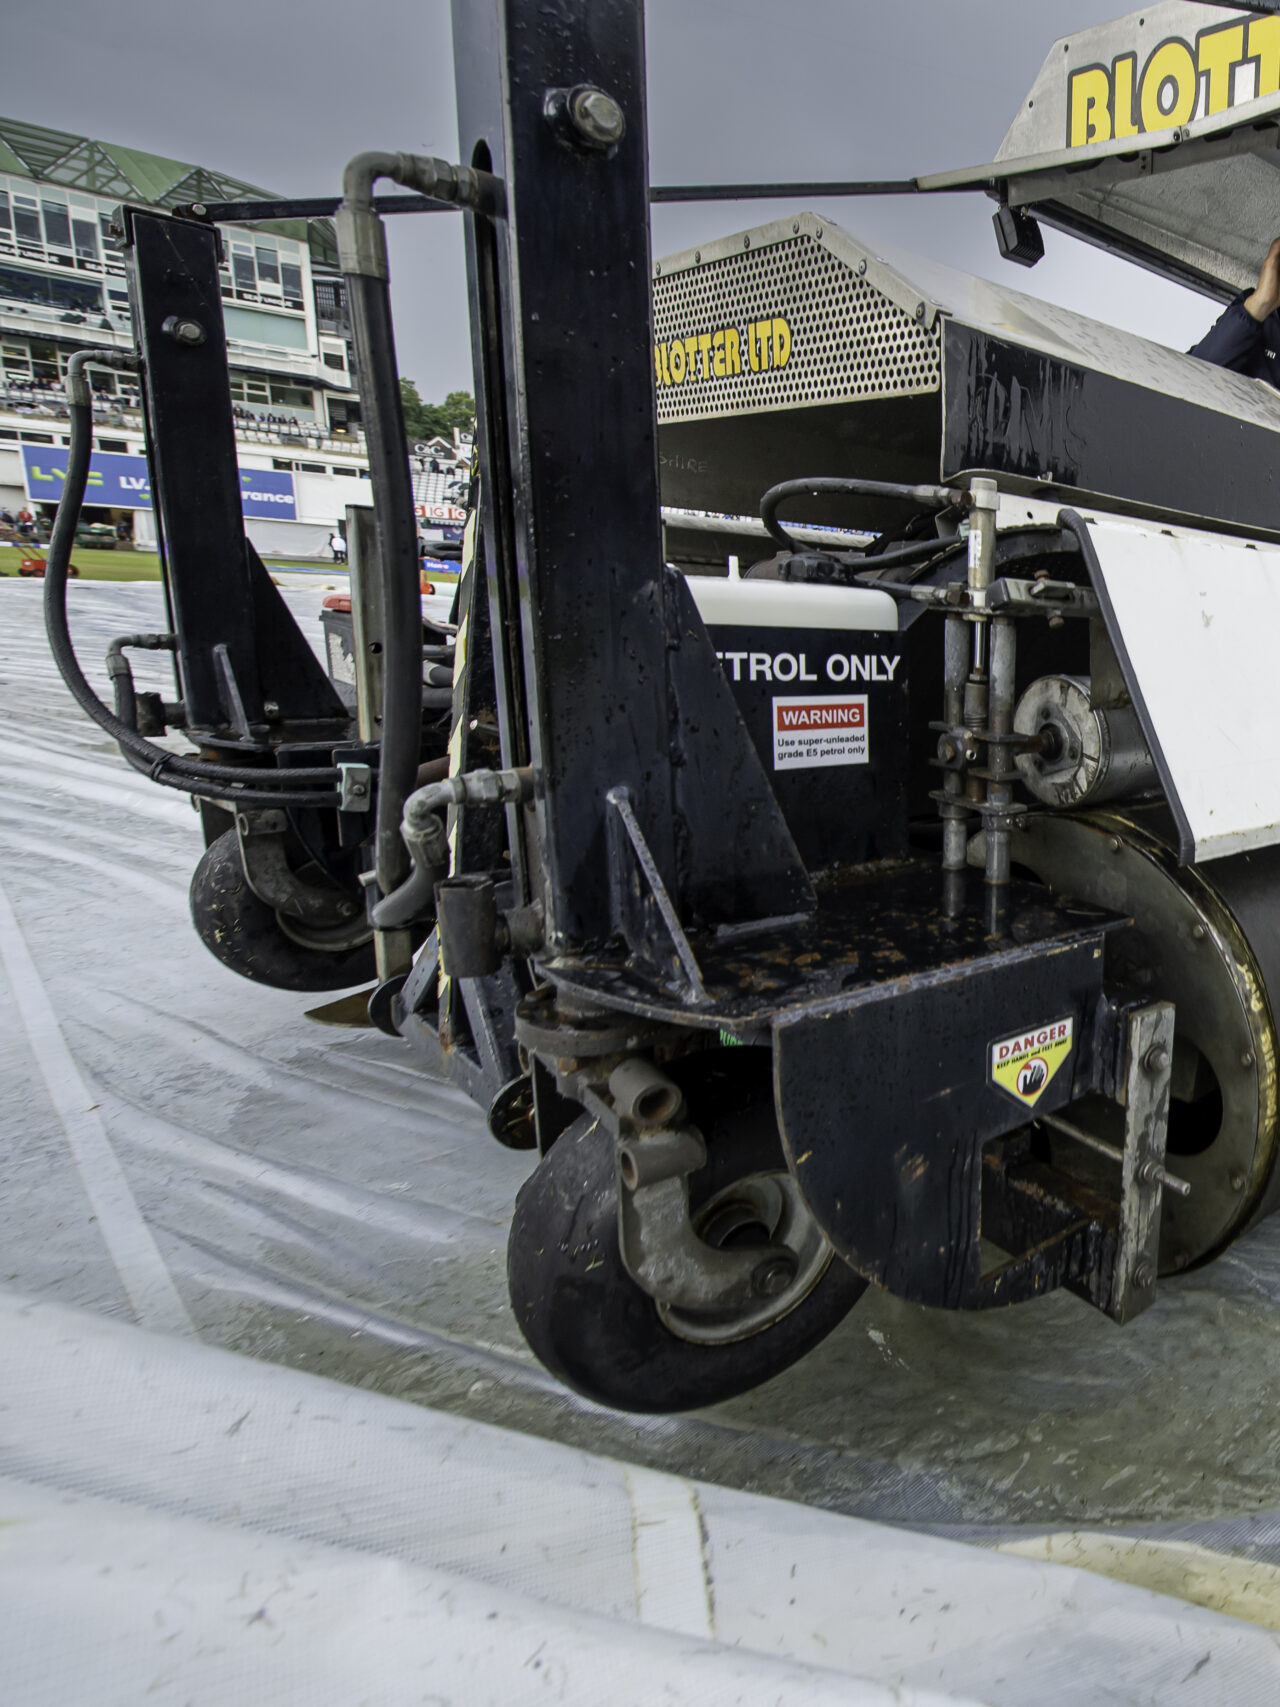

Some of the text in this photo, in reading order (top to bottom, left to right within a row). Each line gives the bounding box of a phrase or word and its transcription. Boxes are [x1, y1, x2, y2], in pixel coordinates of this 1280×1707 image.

[747, 314, 793, 373] LTD
[826, 653, 901, 682] ONLY
[782, 707, 861, 726] WARNING
[777, 734, 865, 748] Use super-unleaded
[777, 745, 866, 761] grade E5 petrol only
[999, 1024, 1067, 1059] DANGER
